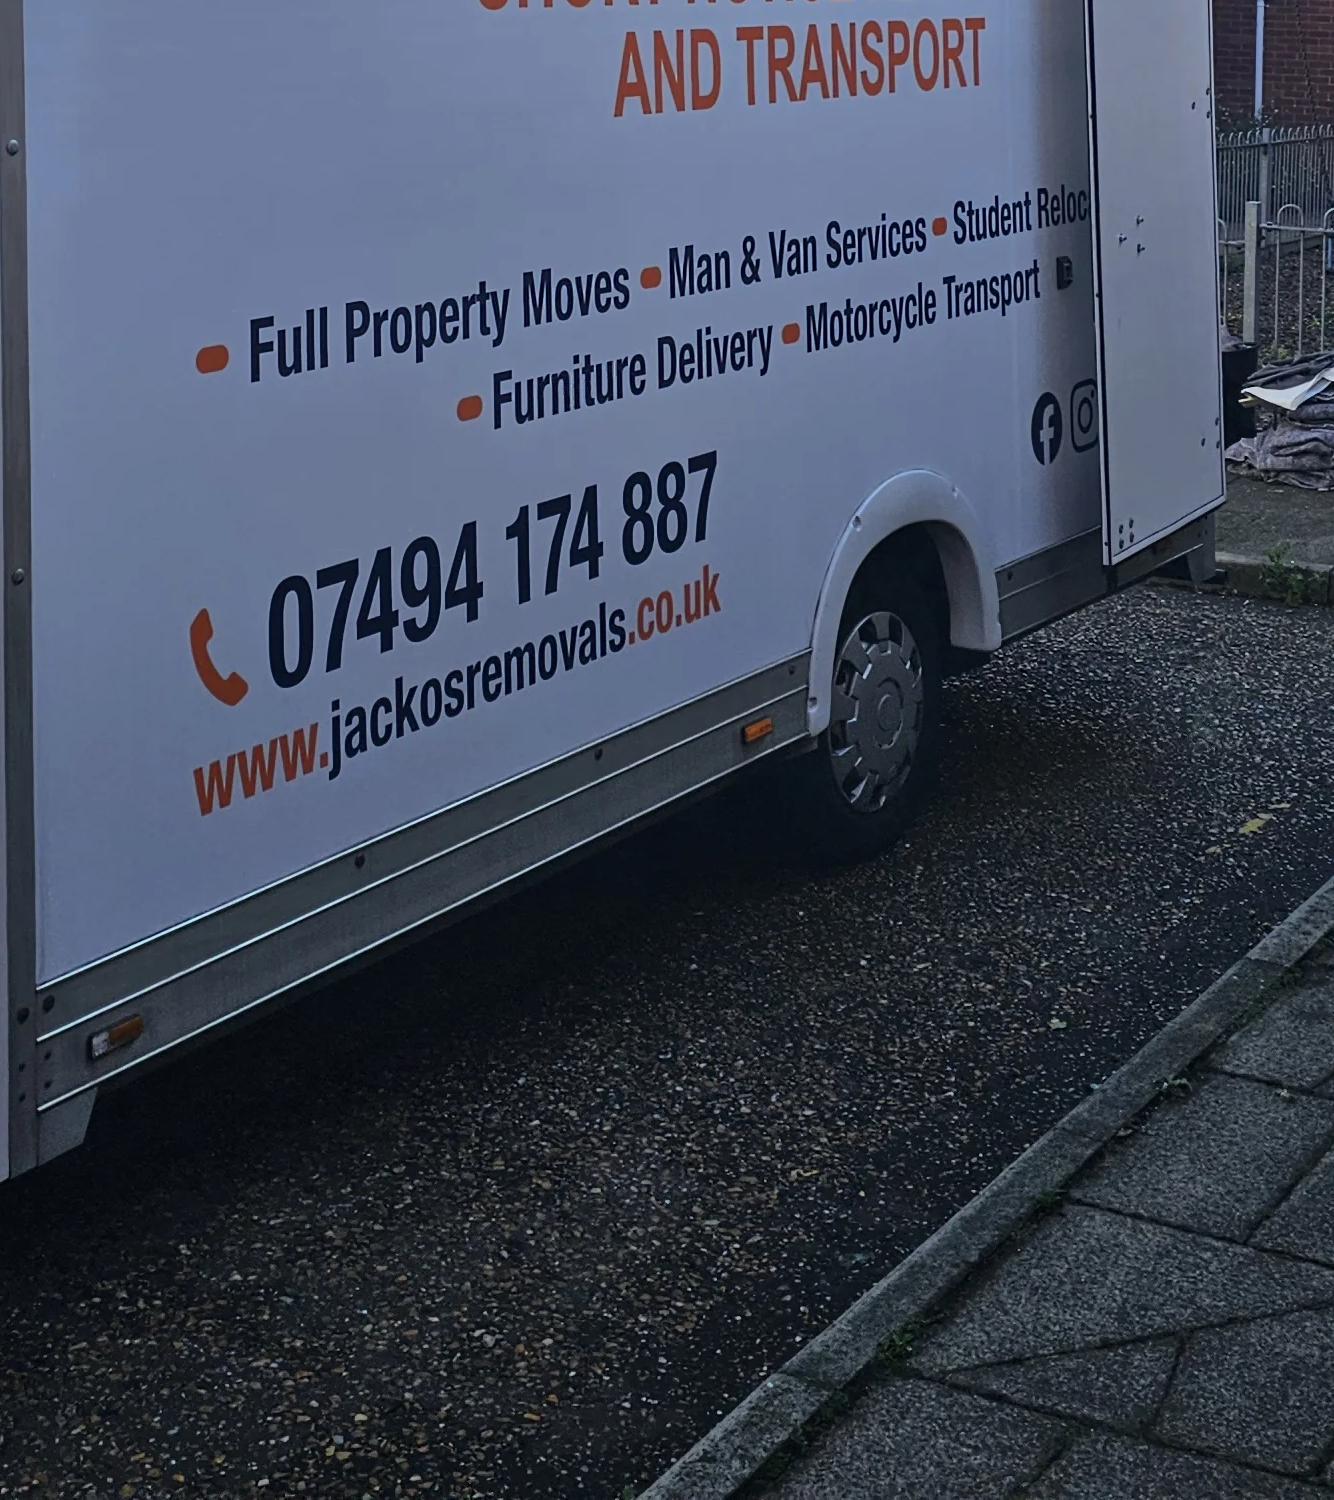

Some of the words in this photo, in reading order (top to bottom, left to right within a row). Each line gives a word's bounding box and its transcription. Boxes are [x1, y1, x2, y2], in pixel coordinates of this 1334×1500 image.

[613, 28, 722, 119] AND
[736, 17, 987, 106] TRANSPORT
[249, 306, 330, 385] Full
[344, 280, 511, 365] Property
[522, 267, 631, 329] Moves
[668, 244, 731, 300] Man
[740, 235, 762, 286] &
[768, 229, 818, 280] Van
[826, 217, 928, 269] Services
[953, 191, 1033, 246] Student
[1036, 184, 1091, 230] Reloc
[492, 353, 647, 430] Furniture
[657, 323, 774, 391] Delivery
[806, 280, 937, 355] Motorcycle
[942, 258, 1041, 320] Transport
[268, 520, 485, 690] 07494
[505, 483, 604, 607] 174
[621, 449, 719, 567] 887
[194, 565, 722, 816] www.jackosremovals.co.uk
